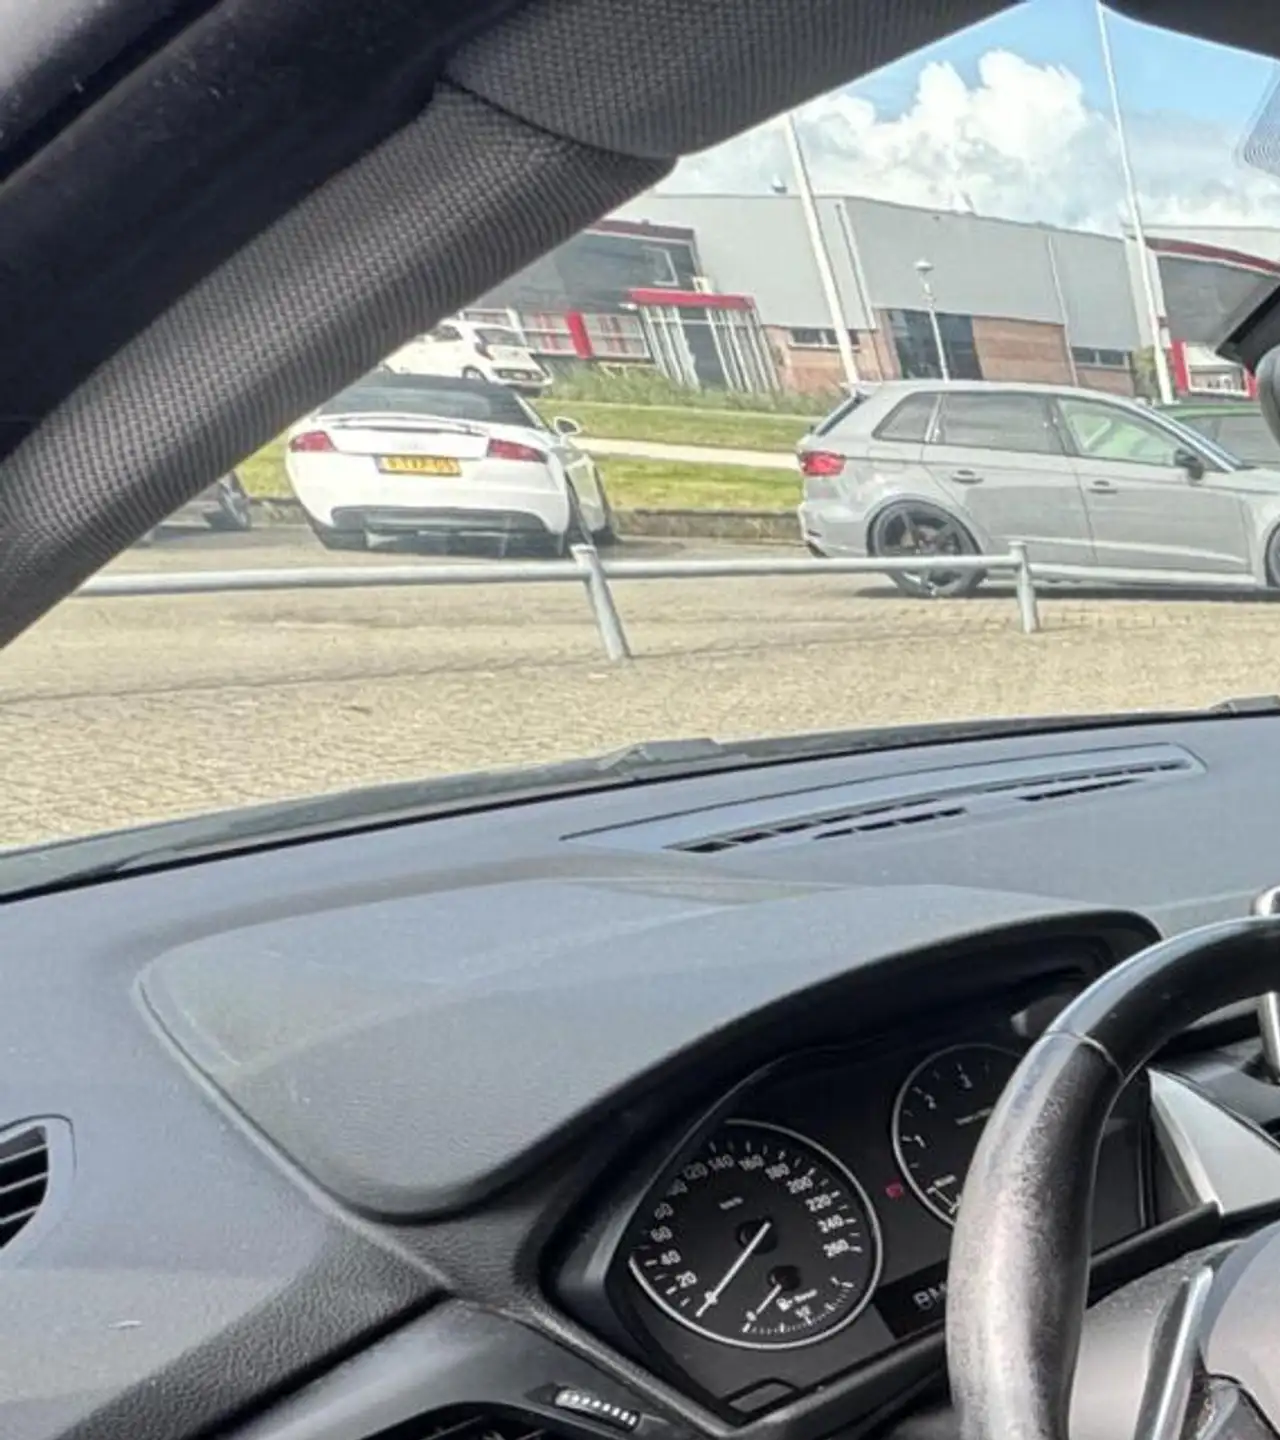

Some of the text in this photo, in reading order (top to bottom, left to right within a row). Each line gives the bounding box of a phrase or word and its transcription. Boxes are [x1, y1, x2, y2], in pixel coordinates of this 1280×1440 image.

[804, 1193, 832, 1212] 220
[817, 1213, 844, 1234] 240
[660, 1249, 681, 1266] 40
[822, 1238, 850, 1258] 260
[675, 1270, 697, 1288] 20
